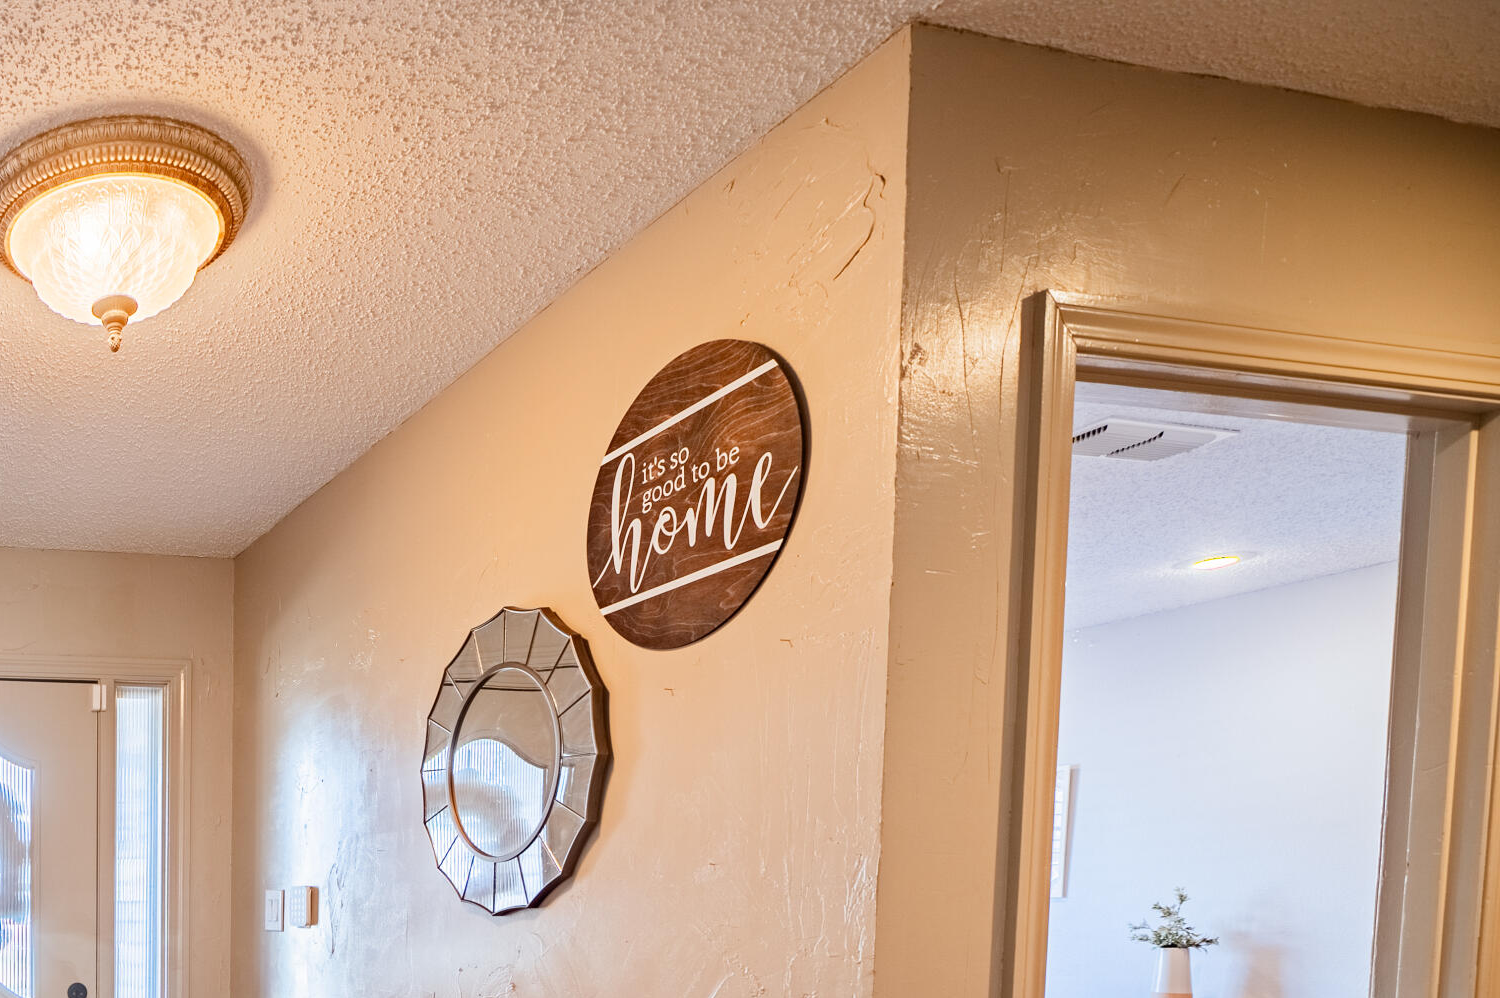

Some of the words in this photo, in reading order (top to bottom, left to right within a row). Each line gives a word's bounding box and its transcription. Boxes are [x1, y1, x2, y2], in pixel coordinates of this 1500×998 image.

[641, 456, 666, 485] it's
[669, 446, 690, 469] so
[641, 466, 687, 514] good
[691, 460, 710, 483] to
[715, 446, 740, 473] be
[593, 452, 799, 594] home
